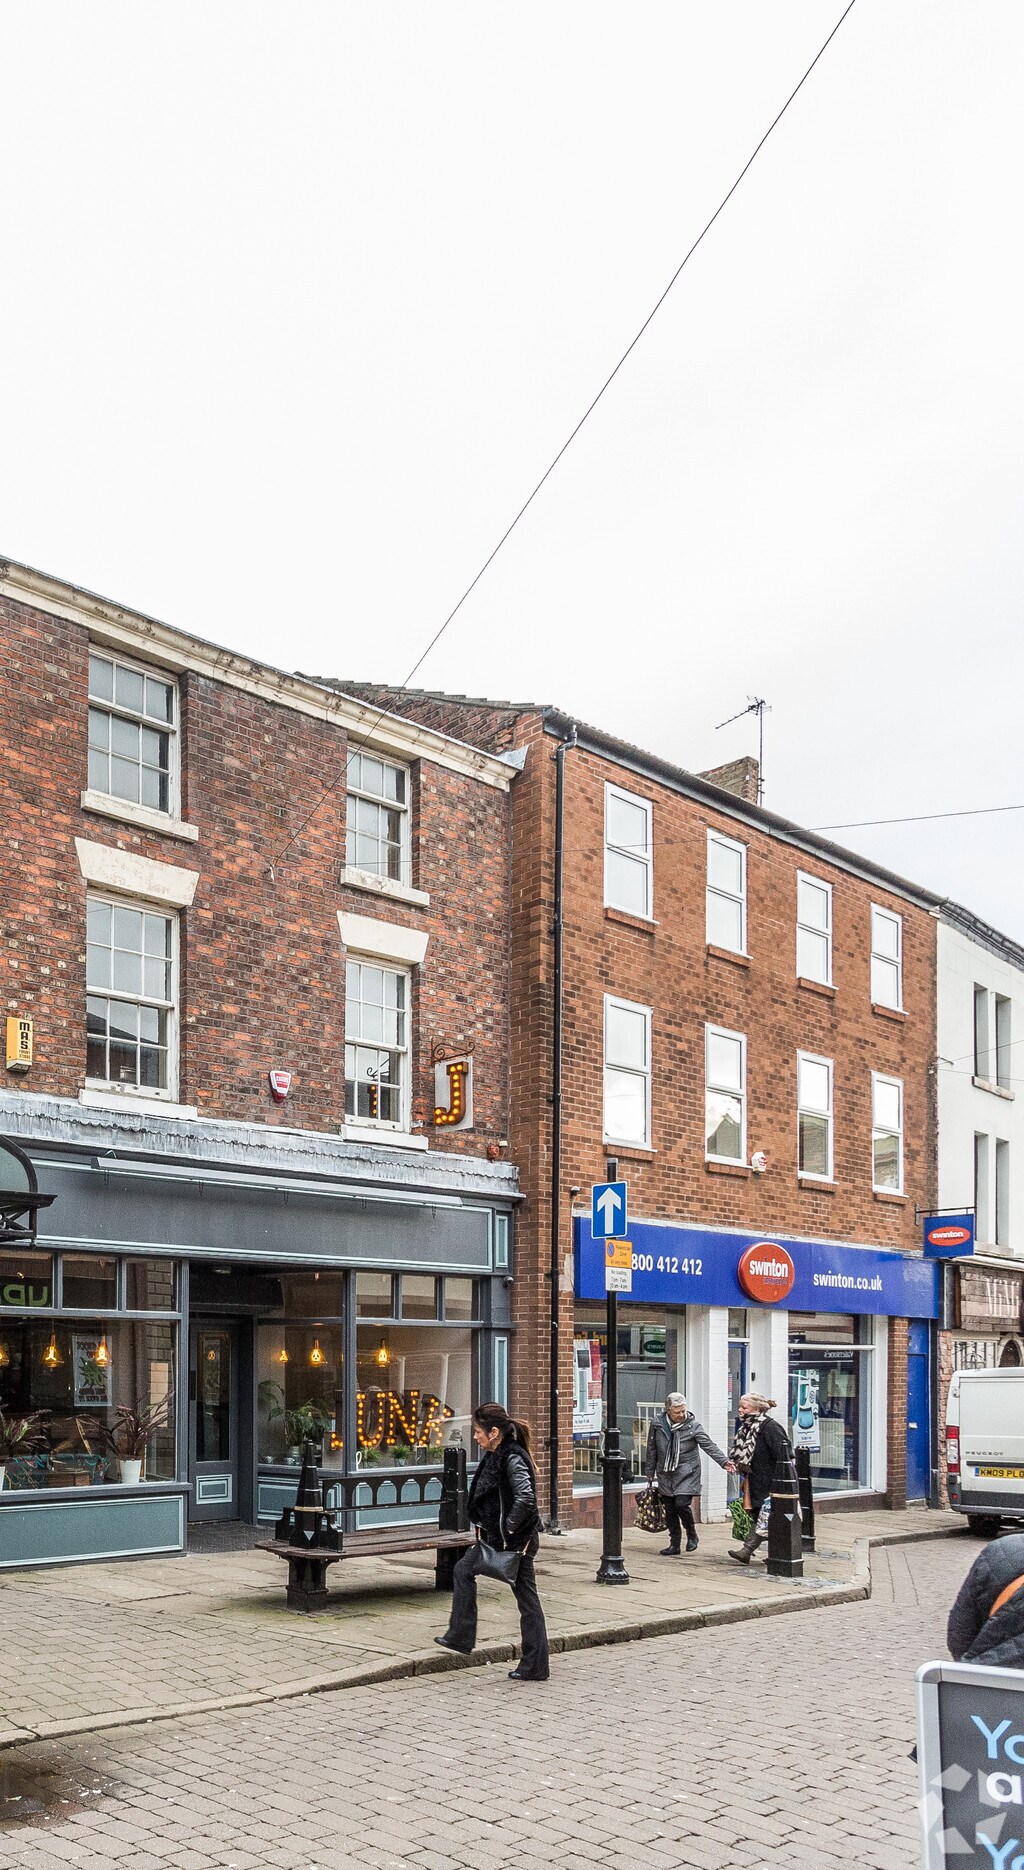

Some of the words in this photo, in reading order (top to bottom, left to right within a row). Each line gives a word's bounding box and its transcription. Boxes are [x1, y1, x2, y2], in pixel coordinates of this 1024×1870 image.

[434, 1062, 468, 1127] J
[932, 1230, 964, 1239] swinton
[656, 1256, 679, 1274] 412
[681, 1258, 703, 1275] 412
[749, 1258, 789, 1277] swinton
[813, 1270, 883, 1291] swinton.co.uk
